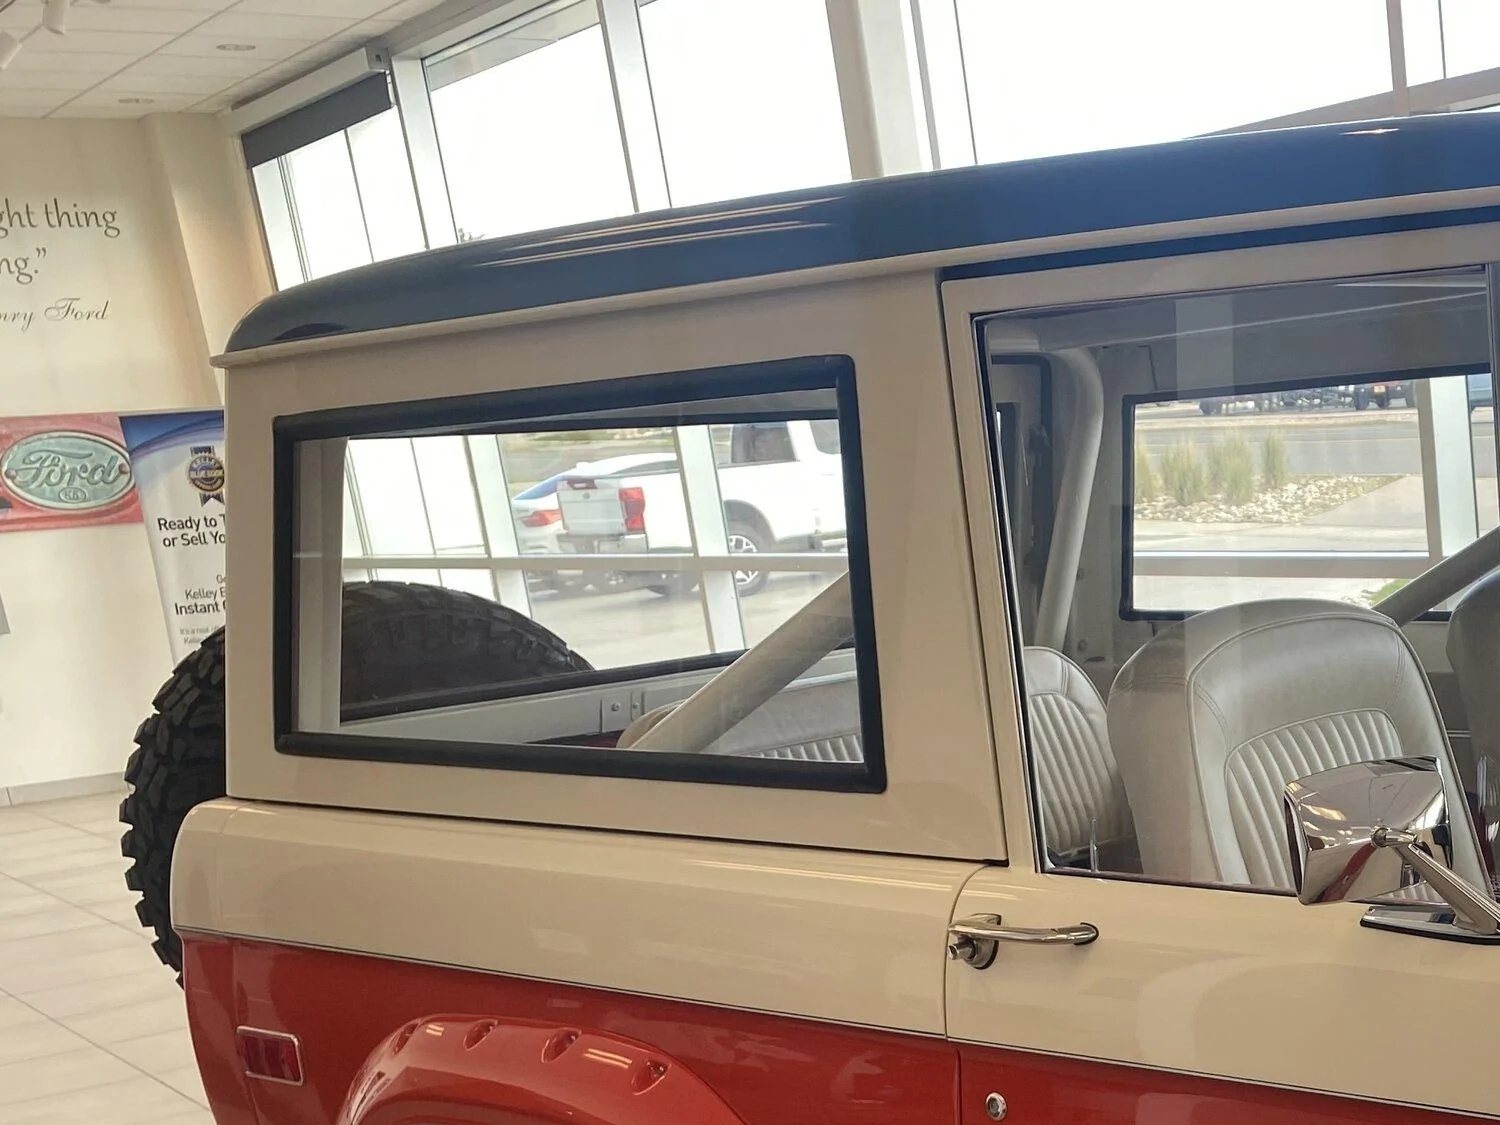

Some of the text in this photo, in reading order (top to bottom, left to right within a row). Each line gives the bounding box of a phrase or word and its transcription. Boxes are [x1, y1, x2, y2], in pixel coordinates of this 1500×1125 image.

[44, 197, 121, 239] thing
[44, 297, 111, 322] Ford
[14, 449, 121, 488] Ford
[157, 516, 201, 532] Ready
[203, 515, 218, 528] to
[163, 536, 178, 547] or
[181, 531, 209, 546] Sell
[185, 588, 218, 601] Kelley
[175, 601, 221, 616] Instant
